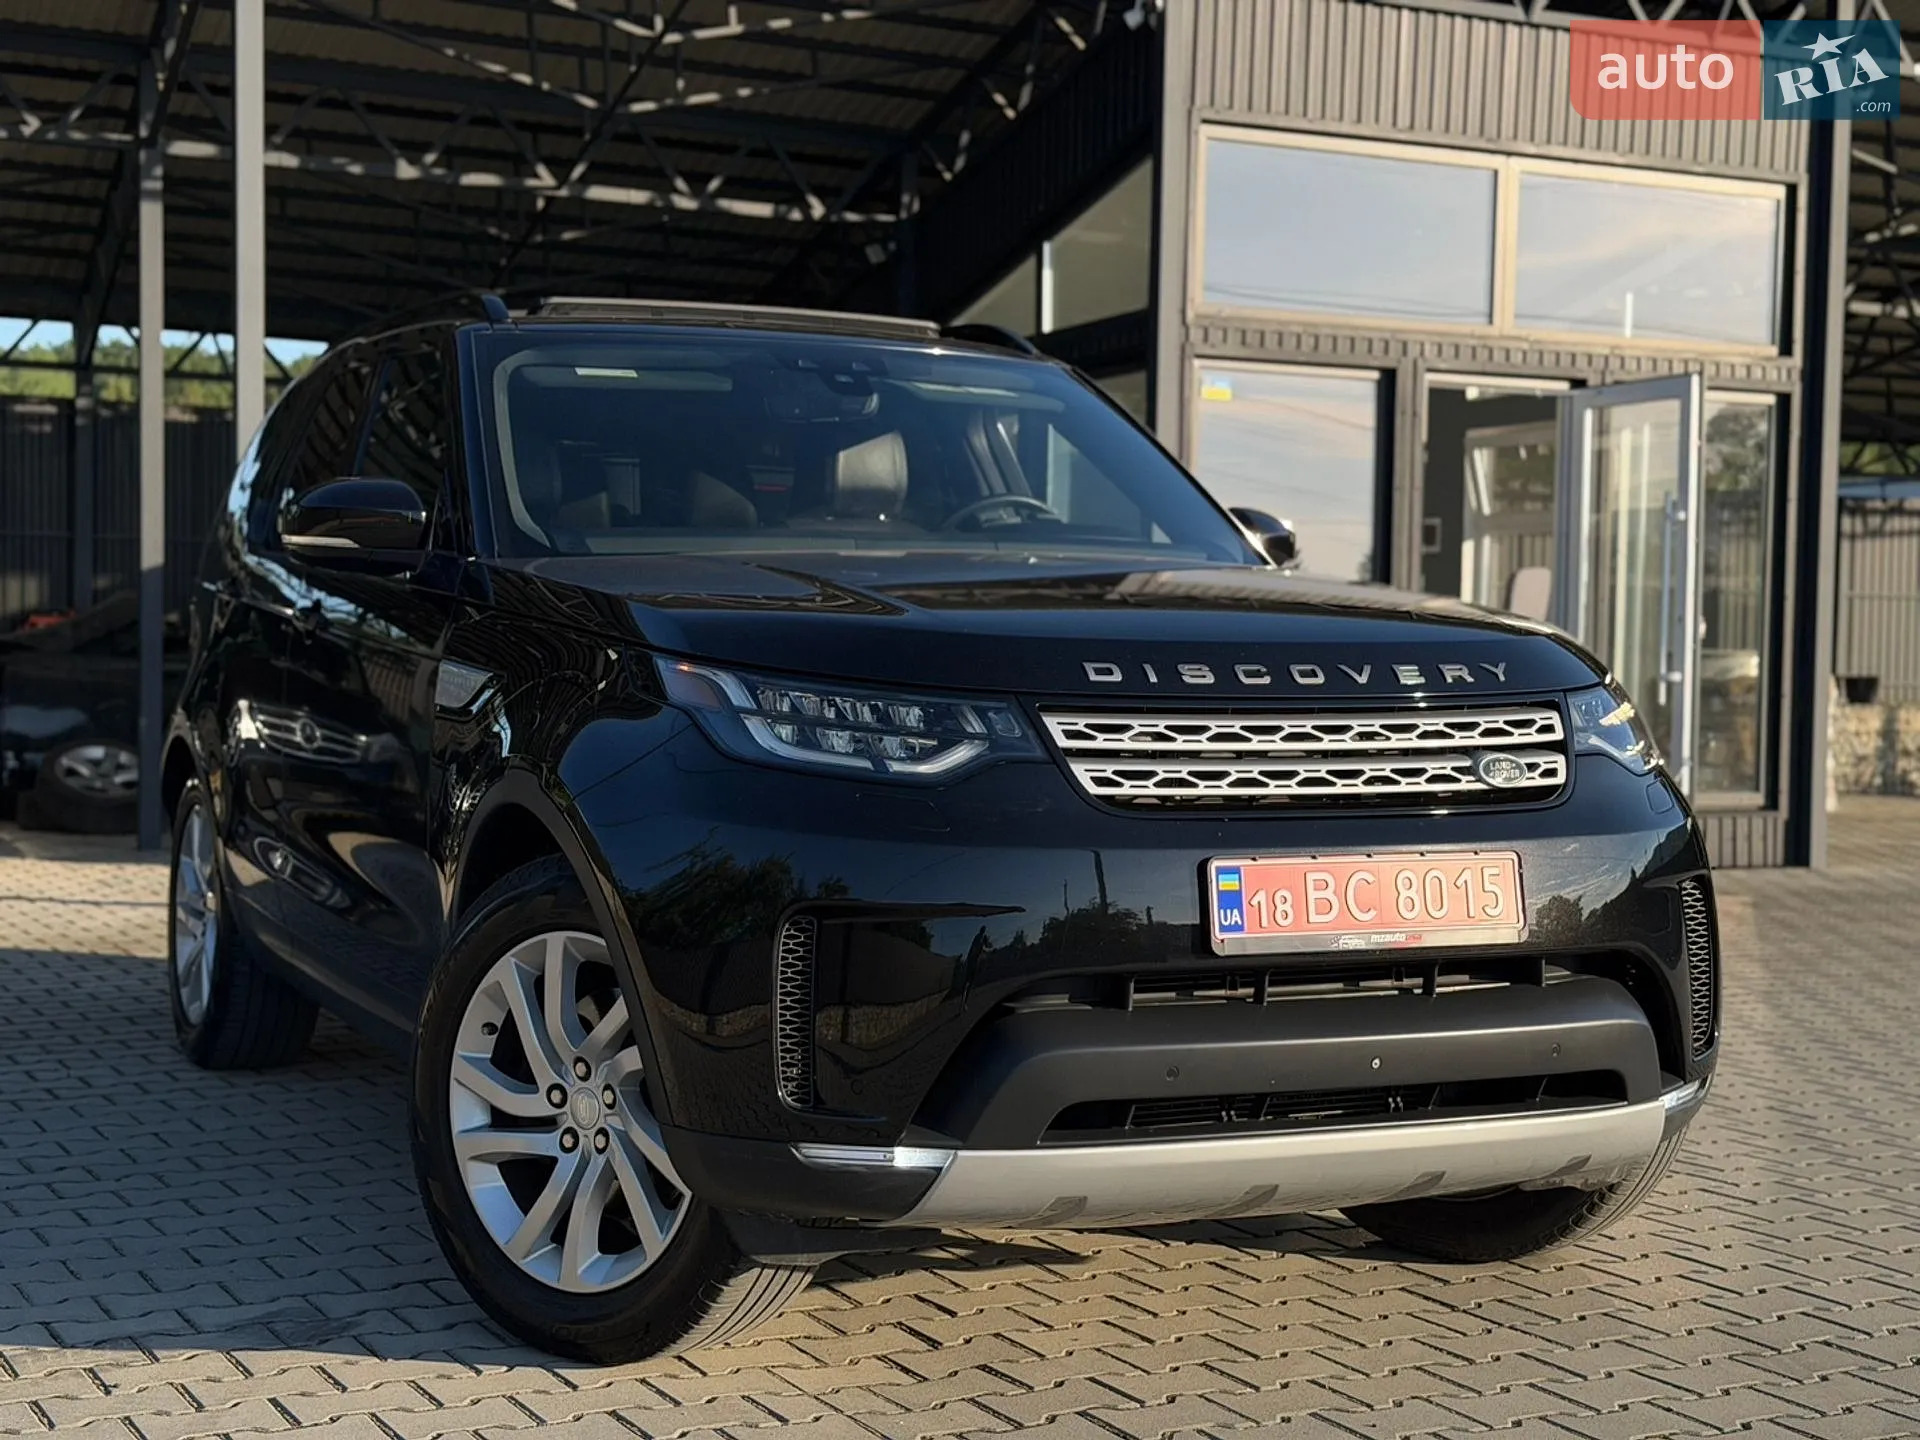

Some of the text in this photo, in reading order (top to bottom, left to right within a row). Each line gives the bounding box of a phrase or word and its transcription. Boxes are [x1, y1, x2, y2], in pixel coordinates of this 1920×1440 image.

[1081, 661, 1508, 686] DISCOVERY
[1489, 761, 1511, 770] LAND
[1494, 769, 1520, 779] ROVER
[1248, 866, 1505, 929] 18 BC 8015
[1220, 908, 1241, 926] UA
